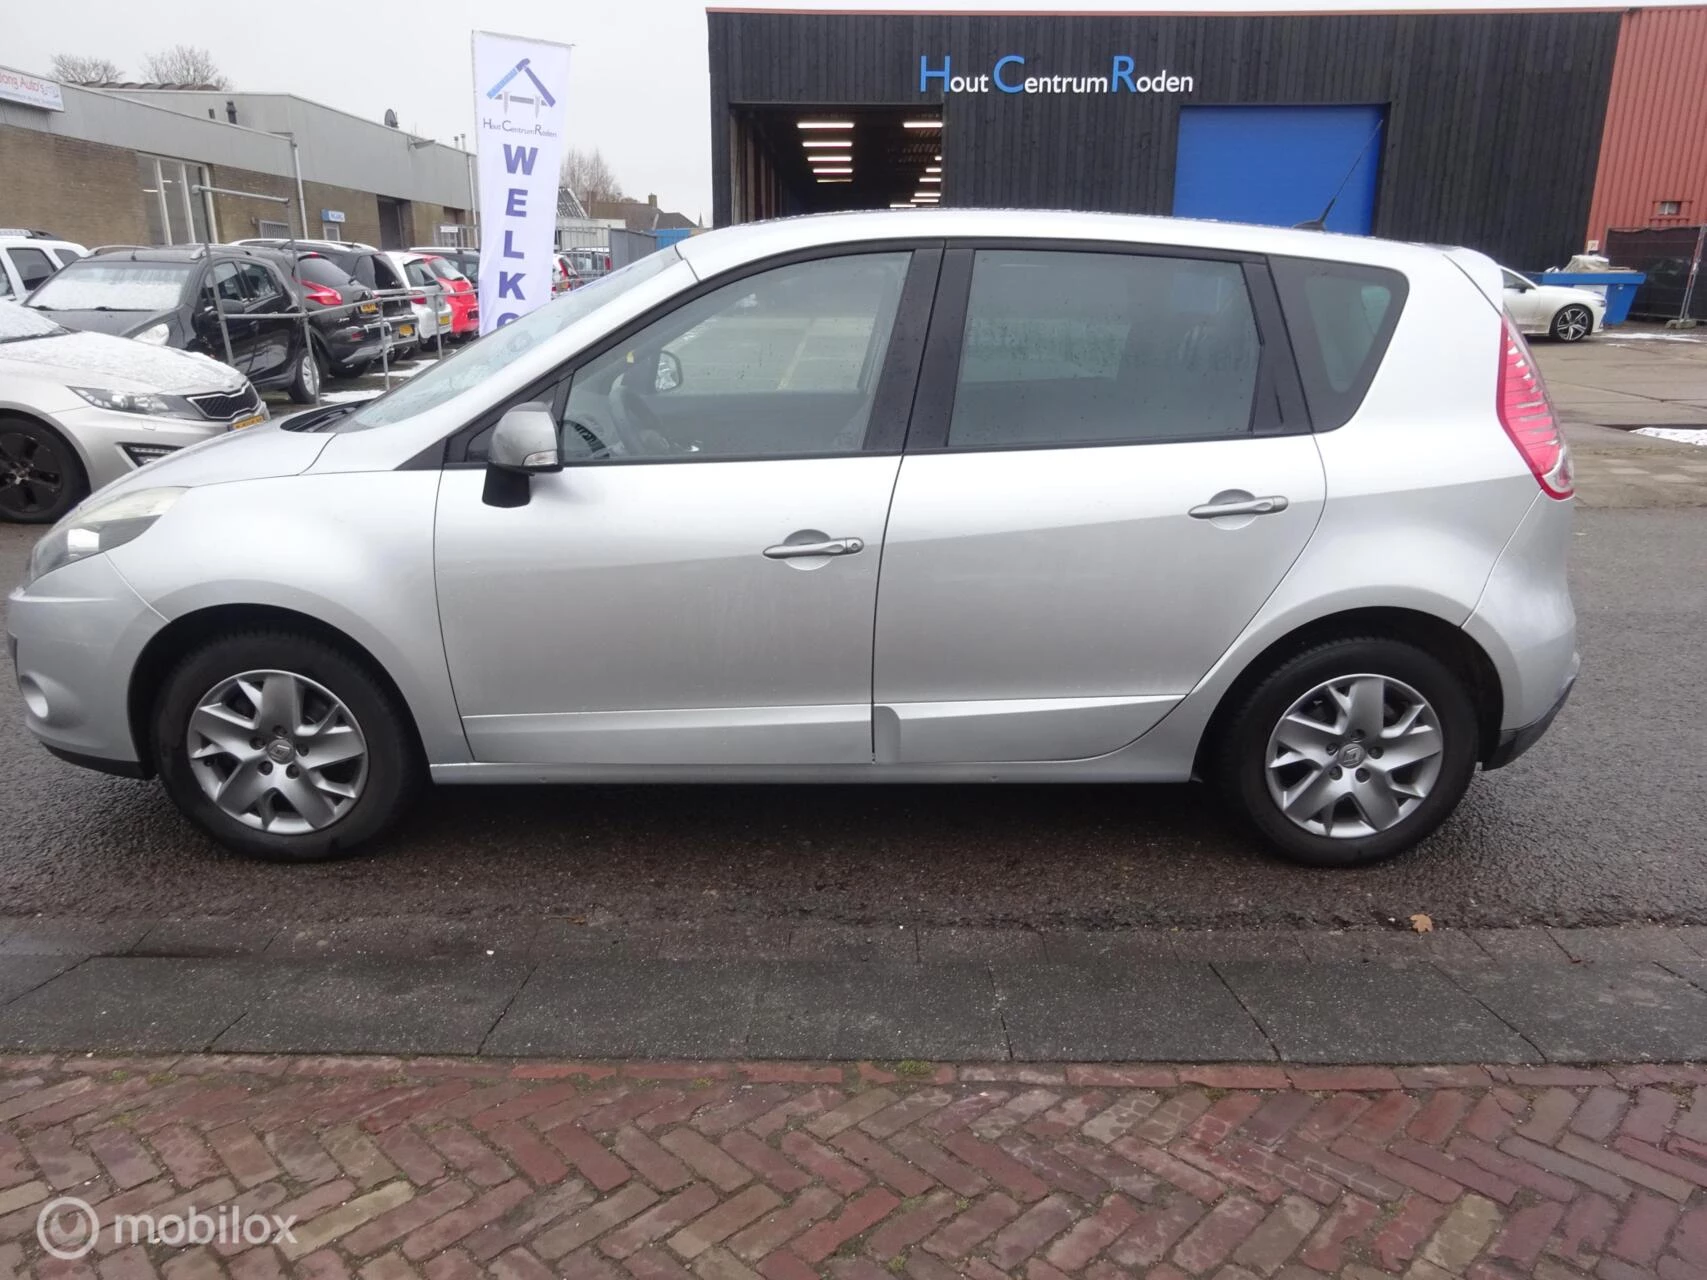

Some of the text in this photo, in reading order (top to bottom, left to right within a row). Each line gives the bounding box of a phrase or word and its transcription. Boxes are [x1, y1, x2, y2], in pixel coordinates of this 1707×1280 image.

[920, 55, 1194, 94] Hout Centrum Roden
